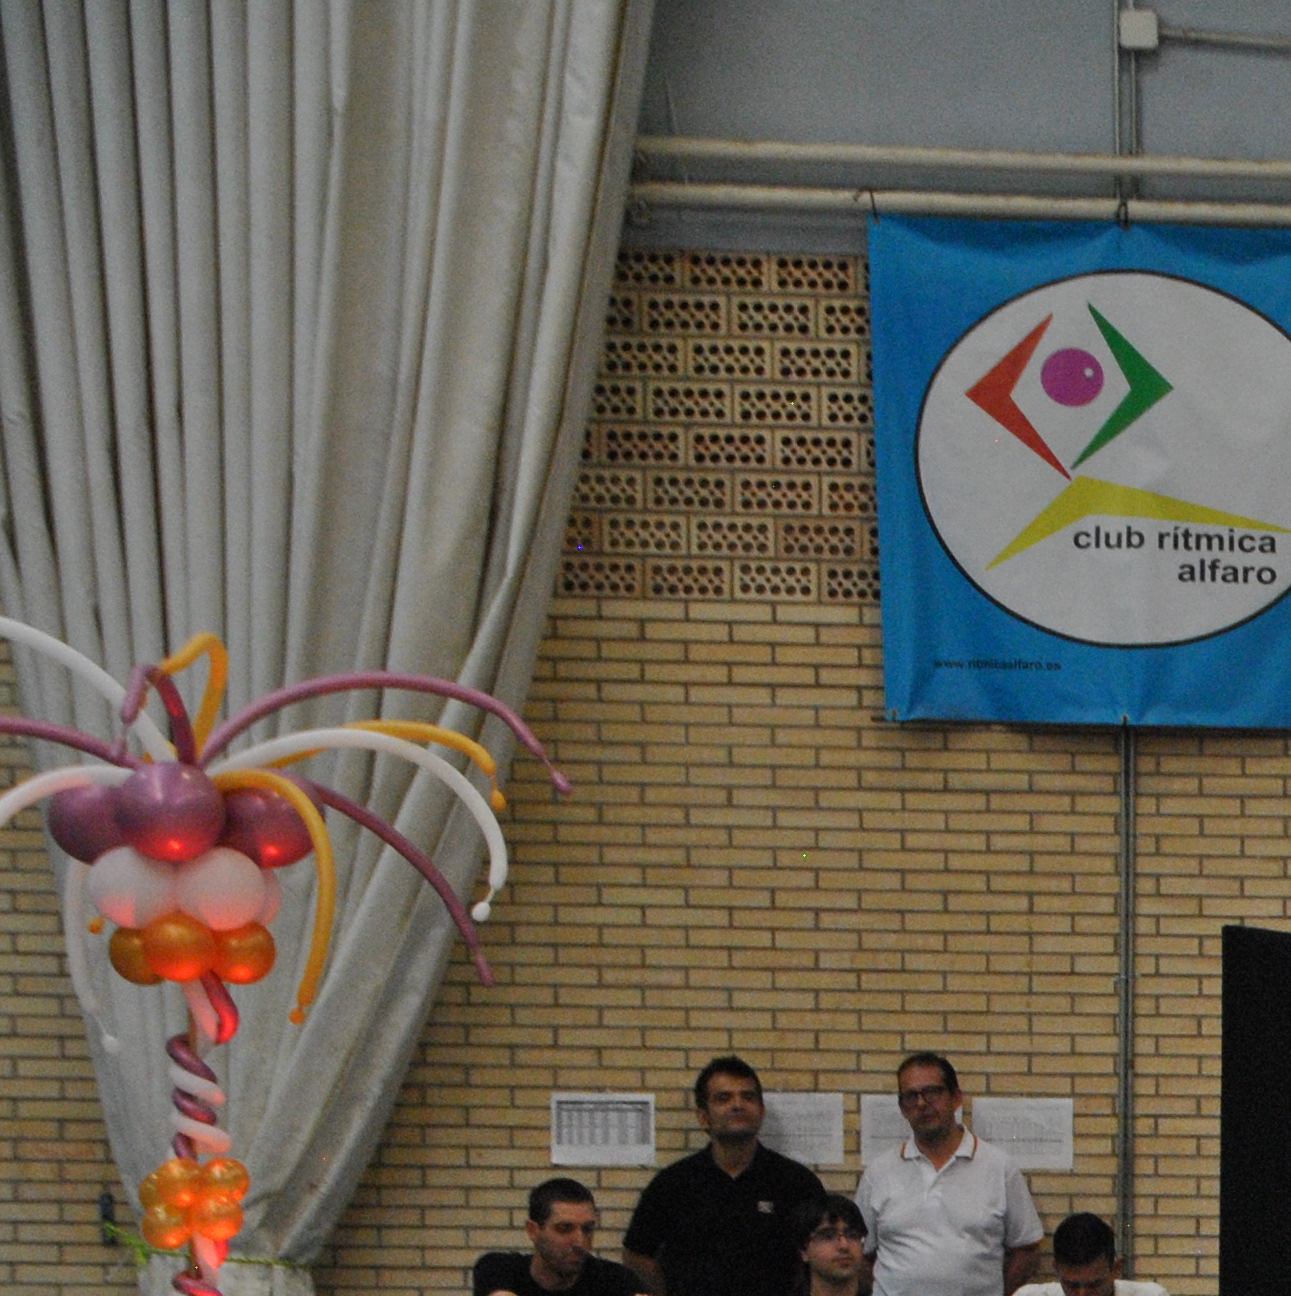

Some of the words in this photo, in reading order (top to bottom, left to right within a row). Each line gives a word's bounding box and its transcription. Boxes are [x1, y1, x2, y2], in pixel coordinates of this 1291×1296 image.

[1073, 525, 1145, 549] club
[1157, 526, 1277, 553] rítmica
[1177, 558, 1277, 585] alfaro
